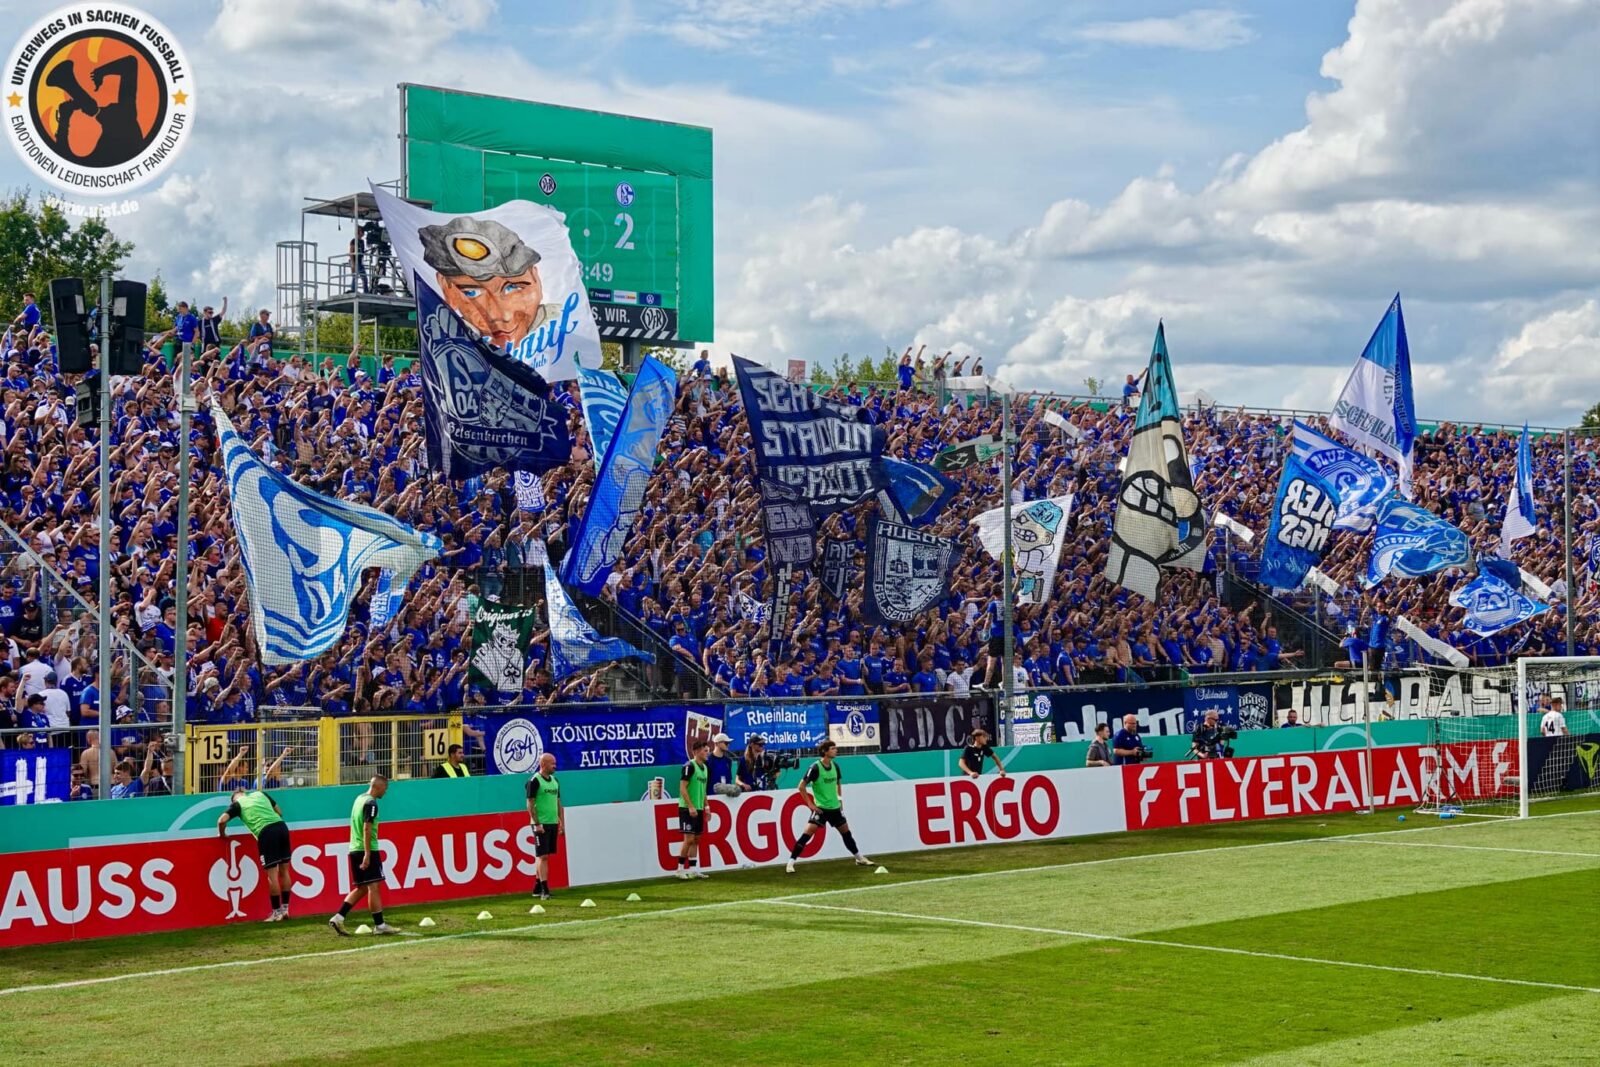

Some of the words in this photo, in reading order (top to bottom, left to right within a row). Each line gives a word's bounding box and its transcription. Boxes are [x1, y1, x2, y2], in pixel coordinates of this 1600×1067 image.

[614, 212, 635, 250] 2
[605, 307, 630, 323] WIR.
[447, 420, 529, 447] Gelsenkirchen
[1310, 449, 1346, 470] BLUE
[878, 523, 953, 550] HUGOS
[746, 707, 807, 726] Rheinland
[1545, 720, 1556, 735] 14
[428, 731, 446, 756] 16
[550, 722, 676, 744] KÖNIGSBLAUER
[761, 731, 798, 744] Schalke
[800, 730, 811, 742] 04
[203, 735, 223, 760] 15
[579, 748, 655, 768] ALTKREIS
[1176, 744, 1480, 824] FLYERALARM
[915, 774, 1060, 846] ERGO
[654, 792, 827, 872] ERGO
[290, 825, 537, 900] STRAUSS
[0, 858, 178, 930] AUSS
